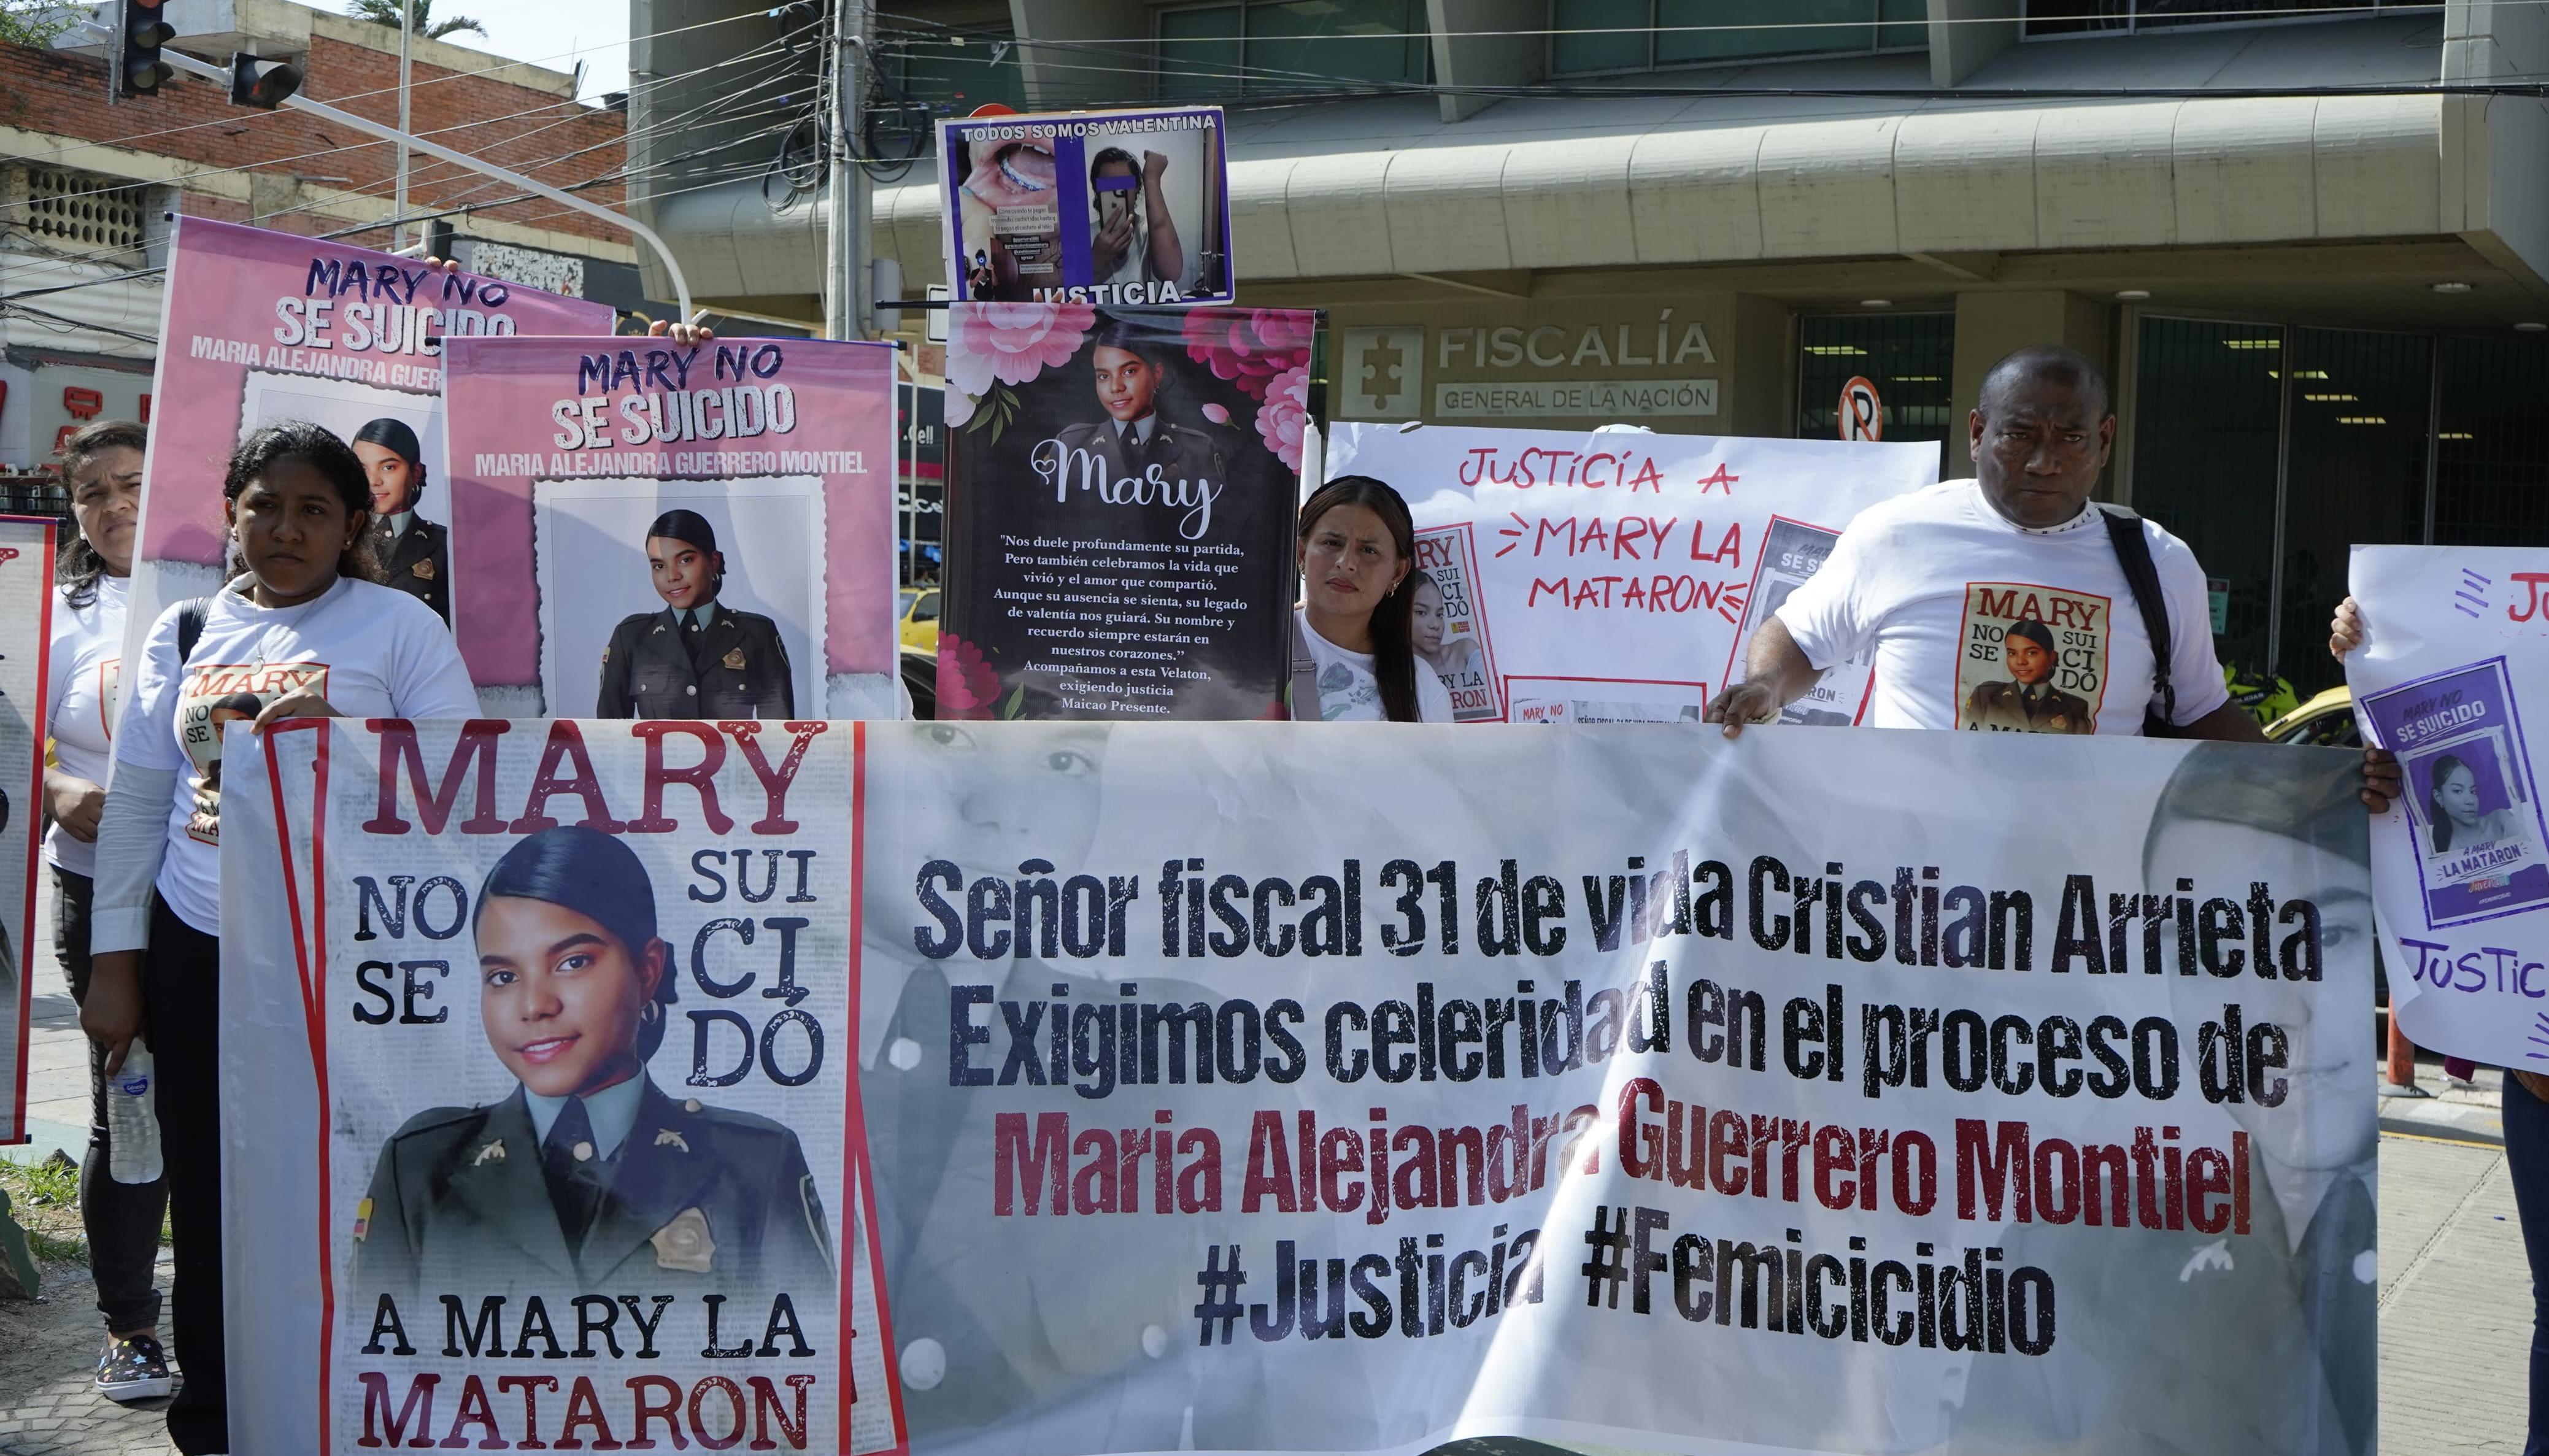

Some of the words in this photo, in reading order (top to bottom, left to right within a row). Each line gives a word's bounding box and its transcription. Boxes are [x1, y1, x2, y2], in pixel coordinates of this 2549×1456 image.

[961, 125, 1025, 142] TODOS
[1032, 122, 1100, 139] SOMOS
[1105, 114, 1216, 135] VALENTINA
[306, 257, 428, 305] MARY
[441, 274, 511, 308] NO
[273, 296, 333, 349] SE
[1440, 307, 1718, 368] FISCALÍA
[190, 334, 261, 367] MARIA
[264, 347, 387, 386] ALEJANDRA
[577, 345, 701, 396] MARY
[714, 343, 784, 382] NO
[1444, 388, 1546, 410] GENERAL
[1552, 389, 1582, 409] DE
[1588, 388, 1616, 409] LA
[1622, 382, 1712, 409] NACIÓN
[551, 396, 614, 451] SE
[620, 383, 797, 446] SUICIDO
[1852, 391, 1873, 441] P
[475, 453, 546, 477] MARIA
[550, 452, 671, 477] ALEJANDRA
[674, 451, 776, 476] GUERRERO
[780, 450, 868, 475] MONTIEL
[1030, 438, 1224, 541] Mary
[1697, 463, 1740, 495] A
[1033, 536, 1069, 549] duele
[1072, 537, 1172, 553] profundamente
[1174, 544, 1190, 554] su
[1193, 542, 1245, 558] partida,
[1533, 516, 1678, 560] MARY
[1691, 520, 1741, 569] LA
[1005, 552, 1034, 565] Pero
[1036, 553, 1089, 568] también
[1092, 557, 1165, 571] celebramos
[1168, 560, 1181, 572] la
[1183, 561, 1211, 574] vida
[1214, 564, 1240, 577] que
[1438, 568, 1460, 582] SUI
[1781, 552, 1803, 570] SE
[1023, 571, 1055, 584] vivió
[1057, 575, 1066, 587] y
[1068, 572, 1081, 585] el
[1084, 576, 1119, 587] amor
[1120, 577, 1146, 591] que
[1148, 579, 1218, 593] compartió.
[1441, 582, 1464, 601] CI
[1529, 575, 1726, 614] MATARON
[993, 588, 1043, 604] Aunque
[1046, 591, 1062, 603] su
[1064, 590, 1120, 605] ausencia
[1123, 595, 1138, 606] se
[1141, 594, 1183, 609] sienta,
[1186, 597, 1201, 609] su
[1204, 597, 1248, 612] legado
[1976, 587, 2102, 632] MARY
[1007, 606, 1024, 618] de
[1026, 607, 1076, 621] valentía
[1079, 611, 1103, 622] nos
[1105, 611, 1151, 625] guiará.
[1154, 613, 1172, 625] Su
[1174, 615, 1225, 628] nombre
[1227, 619, 1236, 631] y
[1027, 626, 1086, 639] recuerdo
[1088, 628, 1141, 643] siempre
[1144, 631, 1191, 644] estarán
[1194, 634, 1210, 645] en
[1971, 623, 2004, 644] NO
[2062, 631, 2097, 649] SUI
[1051, 645, 1106, 658] nuestros
[1969, 643, 1999, 663] SE
[2061, 648, 2096, 672] CI
[190, 669, 318, 698] MARY
[1024, 659, 1117, 676] Acompañamos
[1120, 666, 1128, 676] a
[1130, 666, 1156, 678] esta
[1159, 666, 1212, 682] Velaton,
[1461, 671, 1485, 687] LA
[1059, 680, 1124, 695] exigiendo
[1124, 682, 1174, 698] justicia
[184, 704, 209, 724] NO
[1061, 698, 1107, 711] Maicao
[1110, 700, 1171, 714] Presente.
[1522, 706, 1545, 721] MARY
[1550, 704, 1563, 716] NO
[2402, 697, 2437, 722] MARY
[2439, 689, 2464, 708] NO
[186, 726, 210, 744] SE
[2396, 723, 2418, 743] SE
[2416, 700, 2486, 736] SUICIDO
[361, 719, 828, 836] MARY
[2442, 863, 2461, 877] LA
[2460, 844, 2522, 872] MATARON
[2463, 847, 2470, 856] A
[2470, 841, 2496, 855] MARY
[352, 875, 468, 942] NO
[688, 849, 817, 904] SUI
[914, 858, 1138, 960] Señor
[1158, 857, 1363, 958] fiscal
[1379, 859, 1459, 958] 31
[1475, 859, 1567, 957] de
[1581, 848, 1734, 953] vida
[1748, 855, 2033, 971] Cristian
[2050, 874, 2324, 982] Arrieta
[352, 960, 450, 1025] SE
[691, 917, 811, 1000] CI
[949, 982, 1306, 1100] Exigimos
[1324, 960, 1671, 1083] celeridad
[1687, 979, 1766, 1073] en
[1783, 983, 1845, 1082] el
[1862, 1003, 2180, 1101] proceso
[2197, 1003, 2290, 1109] de
[993, 1109, 1222, 1217] Maria
[1241, 1104, 1600, 1225] Alejandra
[1618, 1077, 1938, 1216] Guerrero
[1954, 1117, 2251, 1236] Montiel
[1194, 1222, 1545, 1347] #Justicia
[1581, 1204, 2057, 1357] #Femicicidio
[360, 1292, 417, 1356] A
[439, 1293, 675, 1360] MARY
[700, 1292, 817, 1358] LA
[356, 1372, 817, 1452] MATARON
